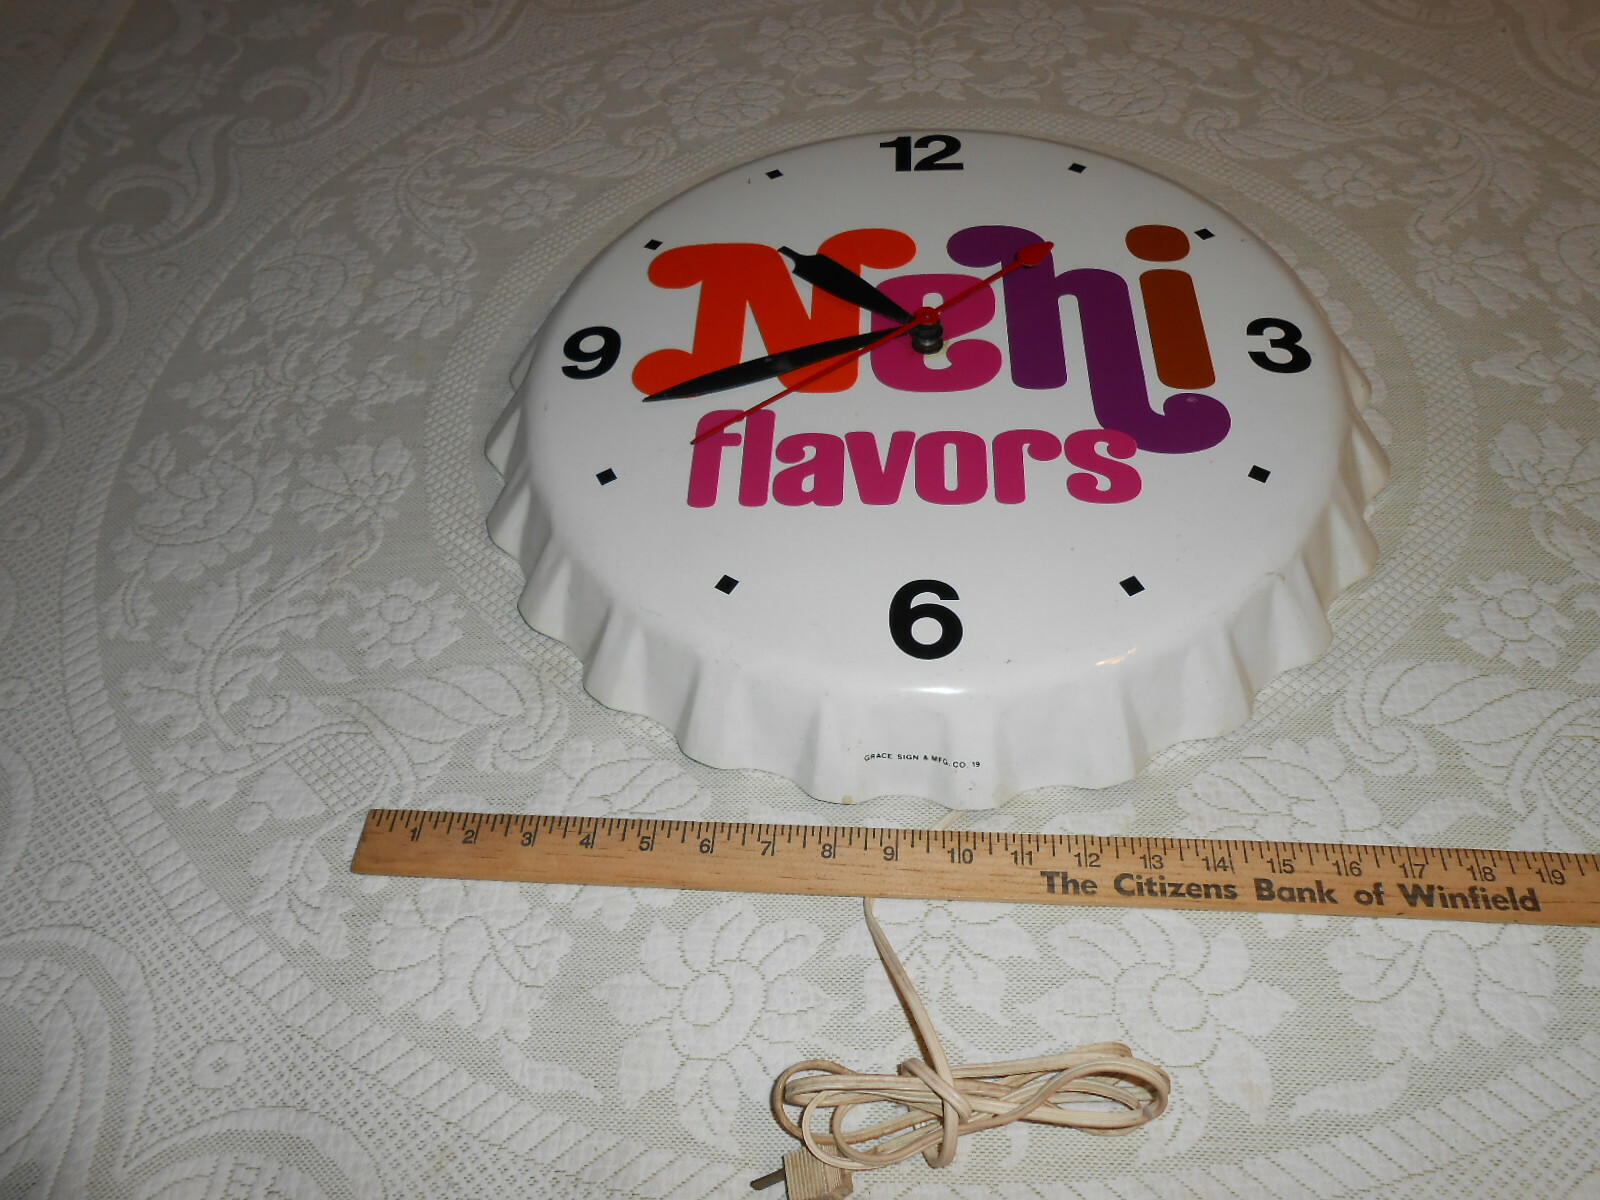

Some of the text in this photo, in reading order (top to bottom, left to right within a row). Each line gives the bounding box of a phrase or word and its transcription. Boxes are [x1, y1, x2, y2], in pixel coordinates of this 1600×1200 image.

[880, 134, 964, 172] 12
[561, 326, 622, 380] 9
[632, 224, 1231, 454] Nehi
[1246, 317, 1312, 374] 3
[686, 408, 1142, 508] flavors
[888, 579, 963, 660] 6
[863, 752, 893, 762] GRACE
[897, 753, 919, 761] SIGN
[462, 830, 475, 844] 2
[520, 831, 533, 847] 3
[579, 833, 592, 849] 4
[638, 836, 651, 852] 5
[699, 840, 712, 854] 6
[760, 841, 773, 856] 7
[821, 844, 834, 859] 8
[883, 846, 895, 861] 9
[948, 848, 974, 864] 10
[1011, 851, 1035, 865] 11
[1074, 853, 1101, 868] 12
[1140, 855, 1166, 870] 13
[1202, 857, 1228, 873] 14
[1267, 858, 1296, 874] 15
[1331, 860, 1363, 877] 16
[1399, 863, 1427, 879] 17
[1467, 866, 1497, 883] 18
[1535, 868, 1566, 885] 19
[1040, 870, 1542, 913] The Citizens Bank of Winfield
